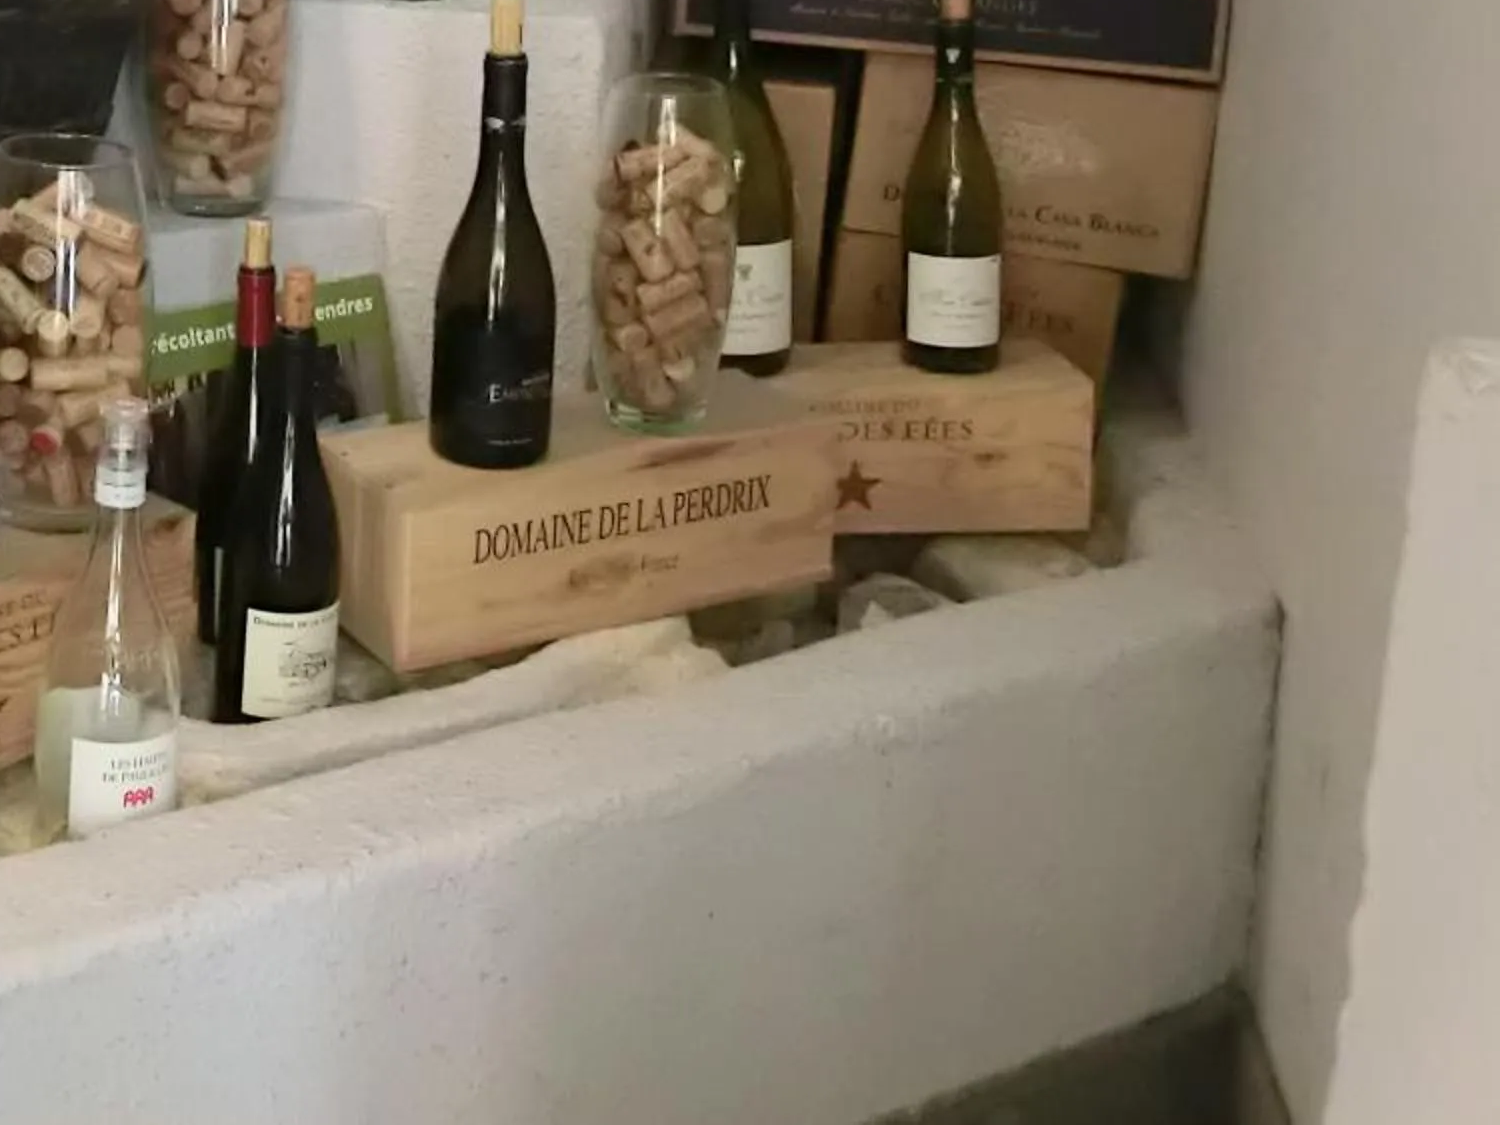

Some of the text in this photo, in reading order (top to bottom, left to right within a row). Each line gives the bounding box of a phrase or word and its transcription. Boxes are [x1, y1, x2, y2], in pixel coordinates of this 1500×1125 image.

[315, 295, 373, 322] endres
[473, 474, 772, 565] DOMAINE DE LA PERDRIX
